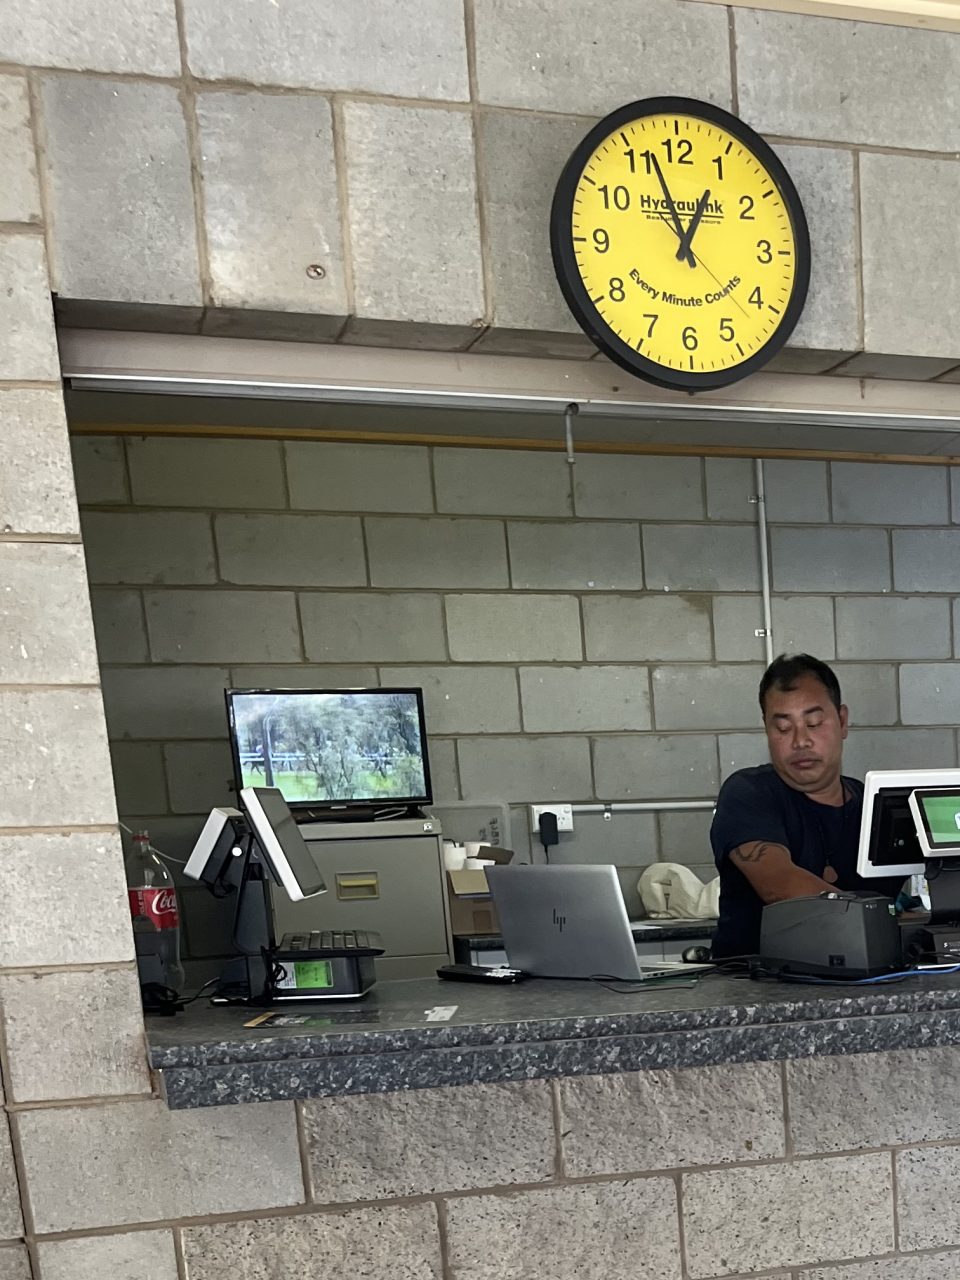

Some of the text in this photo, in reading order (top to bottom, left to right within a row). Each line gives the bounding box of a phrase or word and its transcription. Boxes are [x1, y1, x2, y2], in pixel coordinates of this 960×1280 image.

[623, 148, 652, 175] 11
[661, 139, 694, 166] 12
[711, 155, 724, 181] 1
[597, 184, 631, 211] 10
[738, 195, 756, 220] 2
[592, 228, 610, 254] 9
[755, 239, 773, 265] 3
[608, 277, 626, 303] 8
[628, 268, 741, 307] Every Minute Counts
[747, 286, 764, 310] 4
[642, 313, 660, 338] 7
[681, 326, 699, 351] 6
[718, 317, 735, 342] 5
[552, 908, 566, 933] hp
